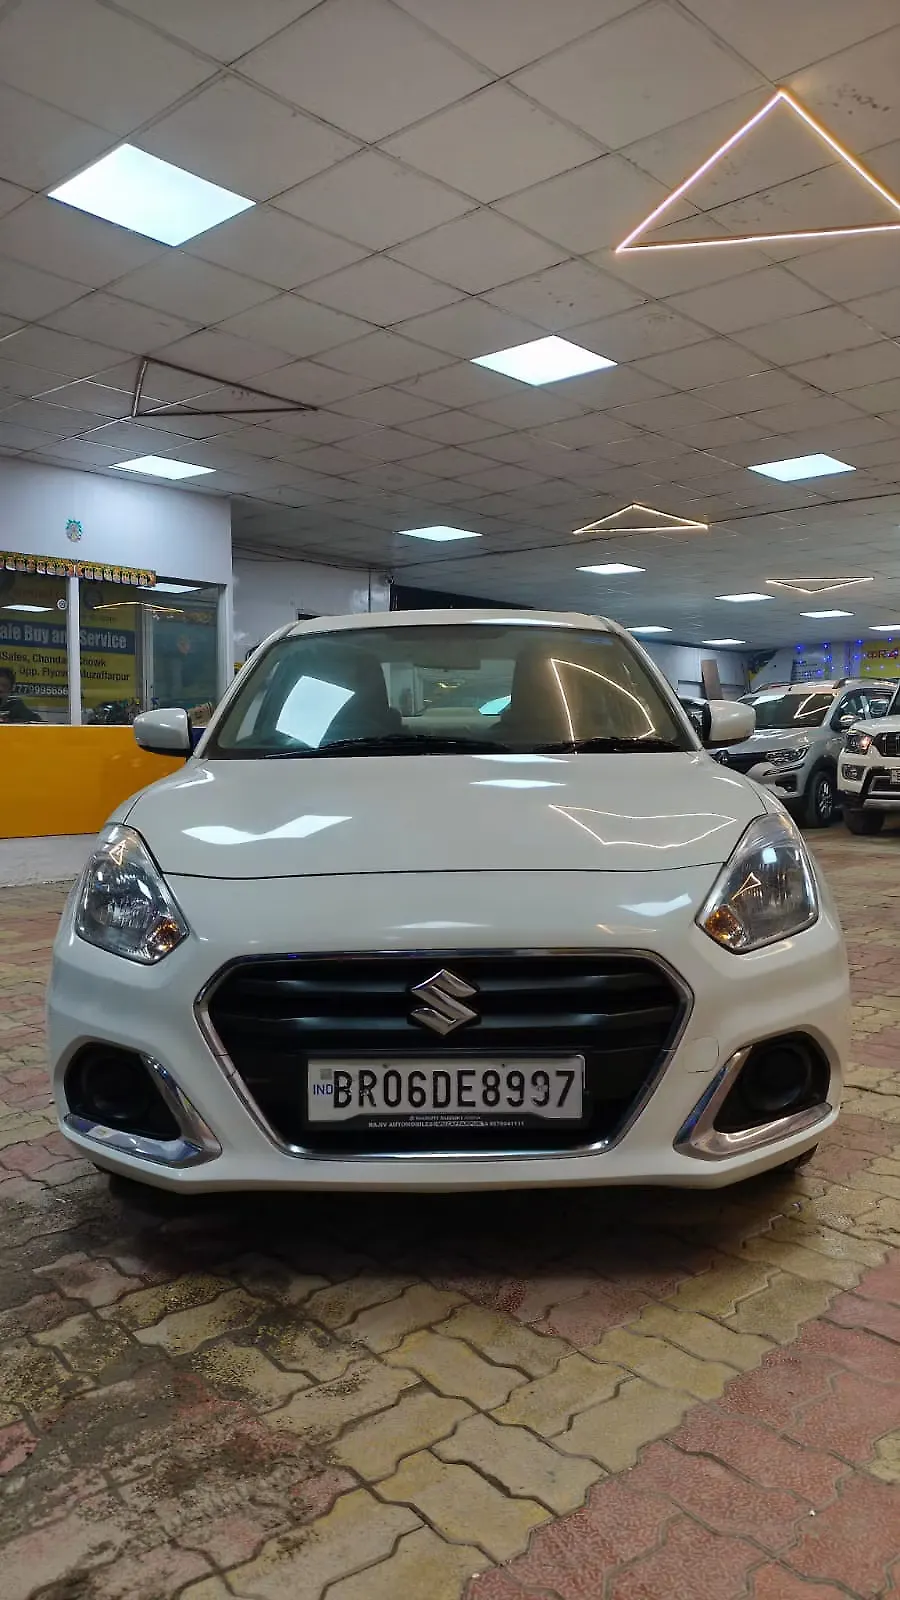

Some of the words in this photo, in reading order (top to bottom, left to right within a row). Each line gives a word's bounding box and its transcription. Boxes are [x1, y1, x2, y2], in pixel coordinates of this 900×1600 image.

[0, 622, 21, 641] ale
[24, 624, 50, 644] Buy
[52, 629, 67, 645] an
[80, 629, 127, 649] Service
[313, 1083, 334, 1096] IND
[333, 1069, 575, 1109] BR06DE8997
